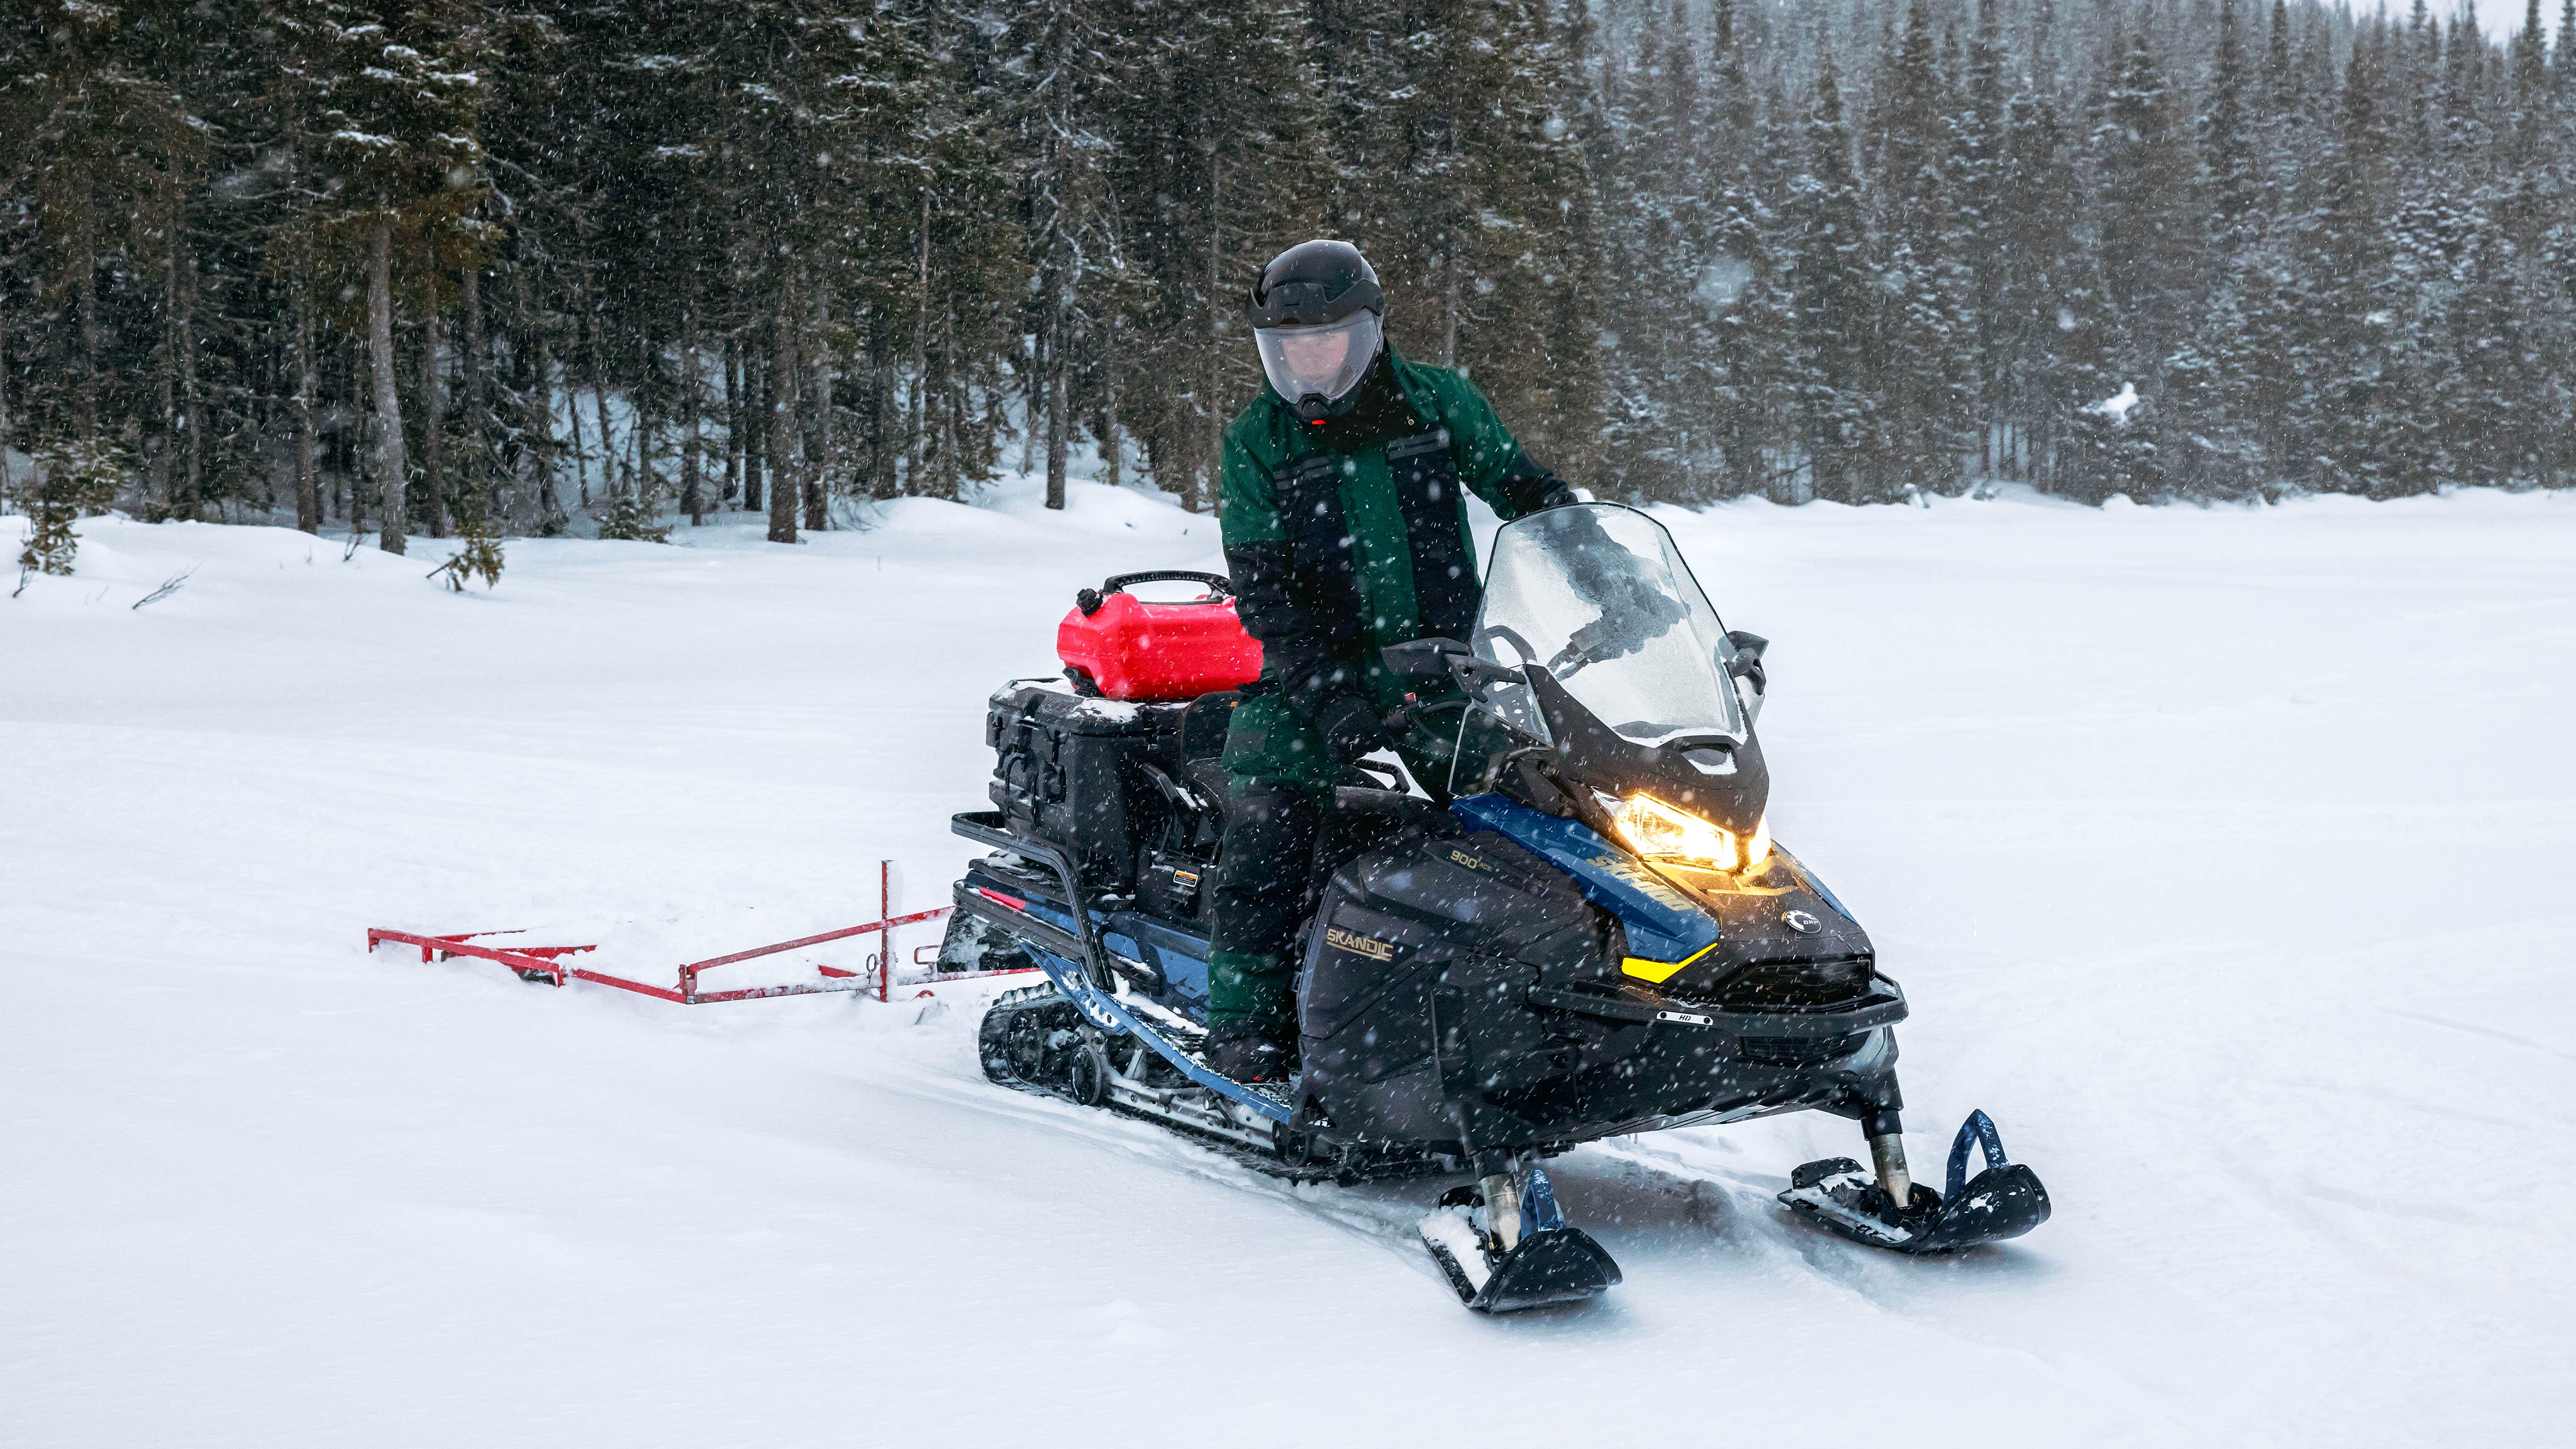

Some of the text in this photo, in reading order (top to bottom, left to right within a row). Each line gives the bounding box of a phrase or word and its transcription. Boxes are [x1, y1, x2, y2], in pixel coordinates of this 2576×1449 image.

[1450, 850, 1492, 872] 900 ACE
[1326, 928, 1394, 957] SKANDIC
